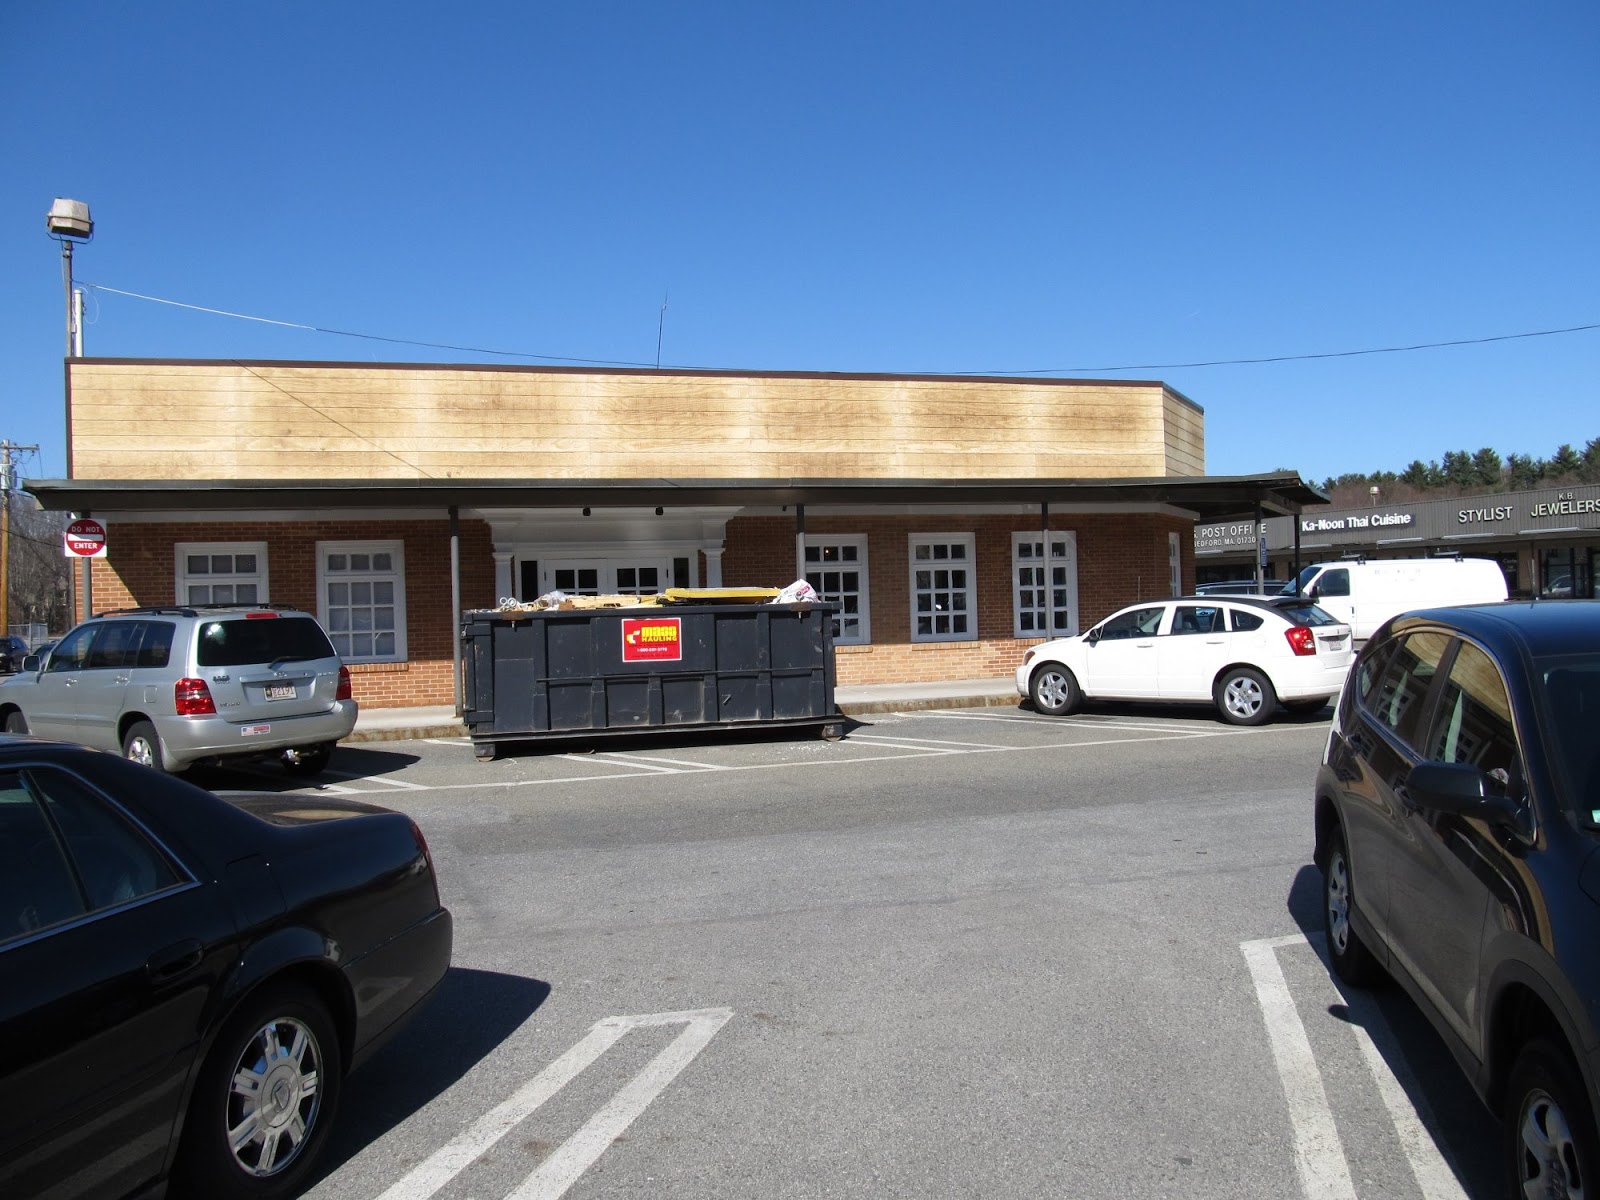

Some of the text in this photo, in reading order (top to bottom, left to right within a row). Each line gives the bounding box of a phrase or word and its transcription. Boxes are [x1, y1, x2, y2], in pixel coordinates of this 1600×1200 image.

[1458, 506, 1514, 524] STYLIST
[1531, 499, 1600, 517] JEWELERS
[1201, 526, 1226, 538] POST
[1230, 523, 1267, 536] OFFIE
[1302, 512, 1412, 532] Ka-Noon Thai Cuisine
[1236, 536, 1257, 545] 01730
